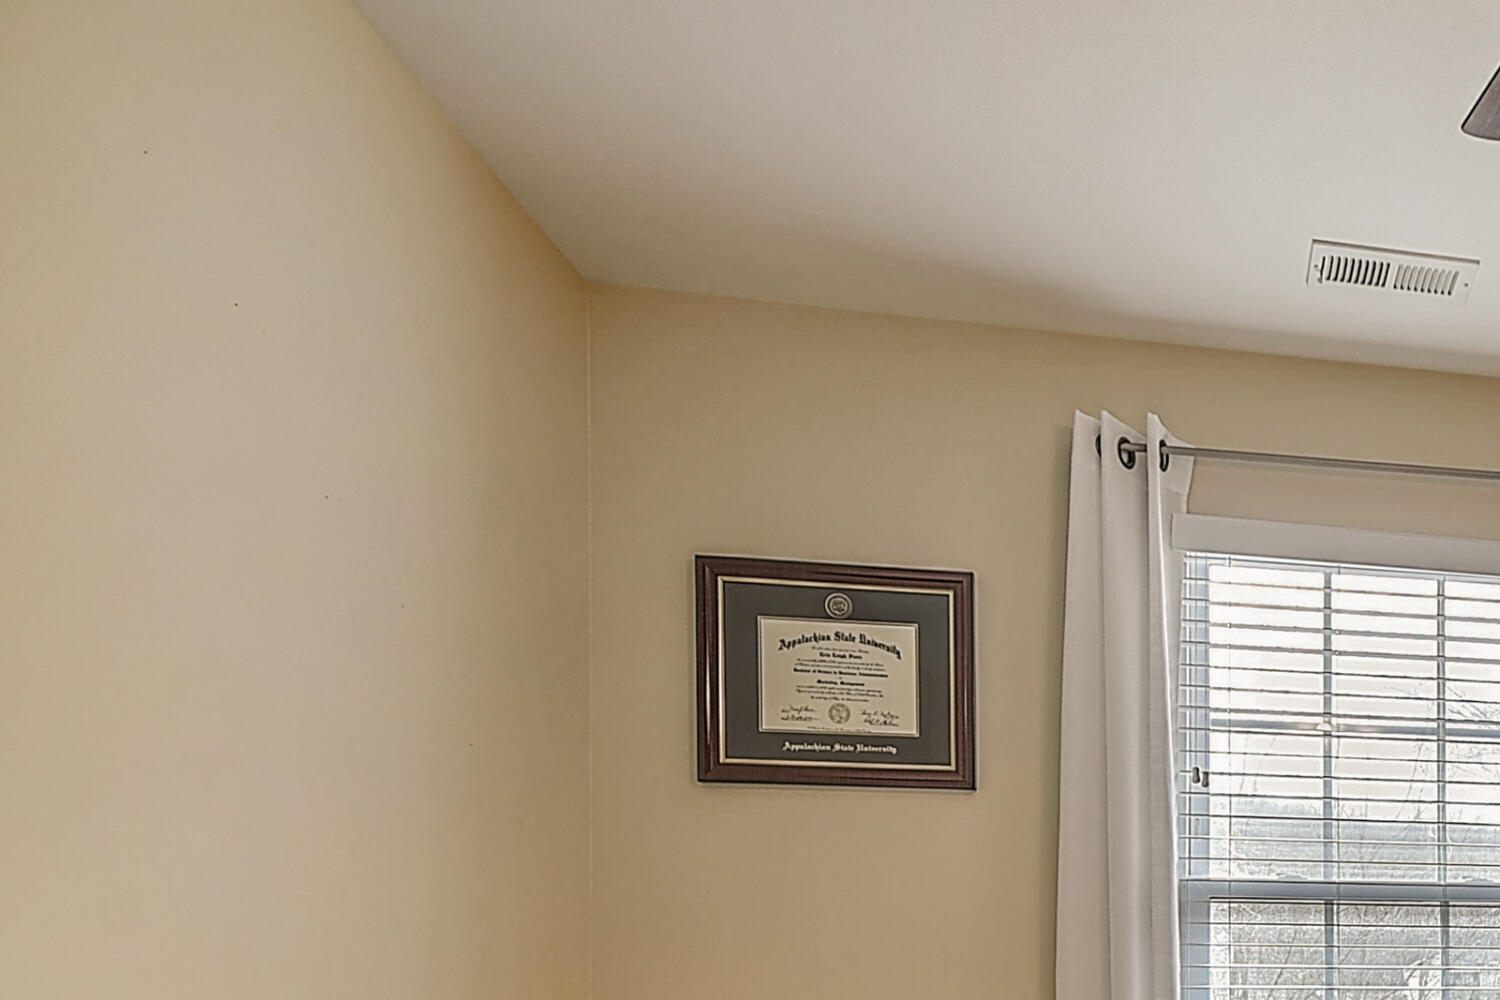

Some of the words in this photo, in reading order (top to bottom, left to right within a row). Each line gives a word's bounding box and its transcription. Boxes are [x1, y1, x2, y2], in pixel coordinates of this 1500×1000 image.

[778, 632, 831, 651] Appalachian
[834, 631, 856, 643] State
[859, 633, 901, 660] University
[782, 741, 831, 752] Appalachian
[833, 742, 854, 753] State
[856, 743, 897, 754] University
